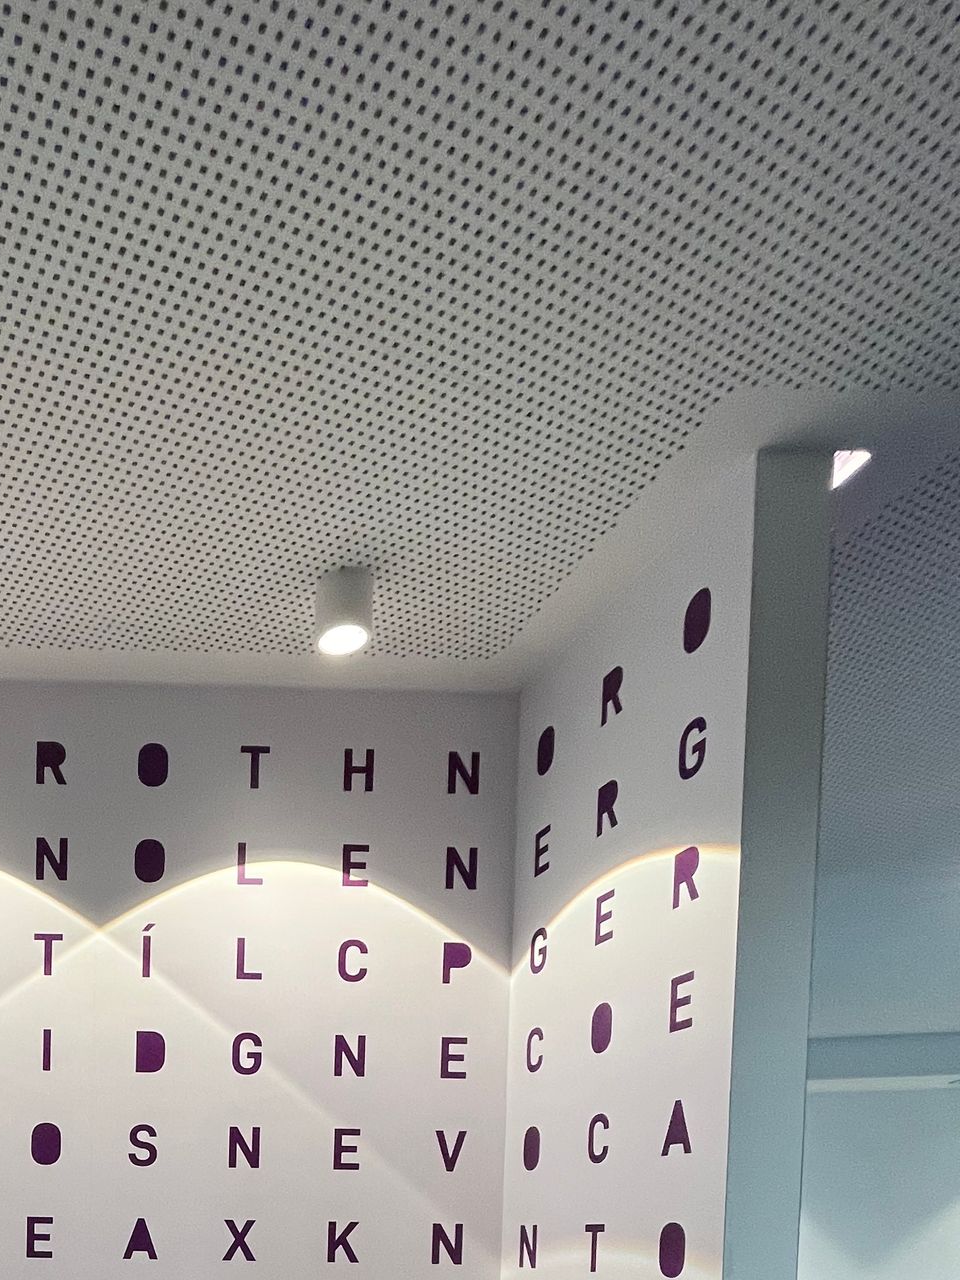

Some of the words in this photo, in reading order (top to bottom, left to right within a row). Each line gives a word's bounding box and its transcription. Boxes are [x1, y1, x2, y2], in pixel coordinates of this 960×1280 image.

[600, 665, 624, 728] R
[35, 740, 68, 786] R
[239, 744, 271, 790] T
[342, 747, 375, 794] H
[446, 750, 481, 796] N
[533, 823, 552, 878] E
[595, 779, 619, 839] R
[678, 716, 708, 781] G
[35, 836, 69, 882] N
[236, 841, 264, 886] L
[341, 843, 370, 888] E
[444, 846, 479, 891] N
[529, 927, 548, 975] G
[594, 888, 616, 947] E
[672, 846, 700, 910] R
[33, 933, 64, 977] T
[141, 923, 157, 978] Í
[235, 937, 263, 981] L
[337, 939, 369, 983] C
[526, 1026, 544, 1073] C
[668, 970, 695, 1034] E
[231, 1031, 263, 1076] G
[333, 1034, 367, 1078] N
[439, 1036, 468, 1080] E
[127, 1123, 158, 1168] S
[228, 1125, 261, 1169] N
[332, 1127, 361, 1171] E
[434, 1129, 468, 1173] V
[587, 1112, 610, 1164] C
[660, 1099, 693, 1157] A
[25, 1215, 54, 1259] E
[122, 1217, 159, 1261] A
[221, 1219, 257, 1262] X
[326, 1220, 360, 1264] K
[431, 1222, 464, 1266] N
[518, 1224, 538, 1269] N
[584, 1223, 606, 1273] T
